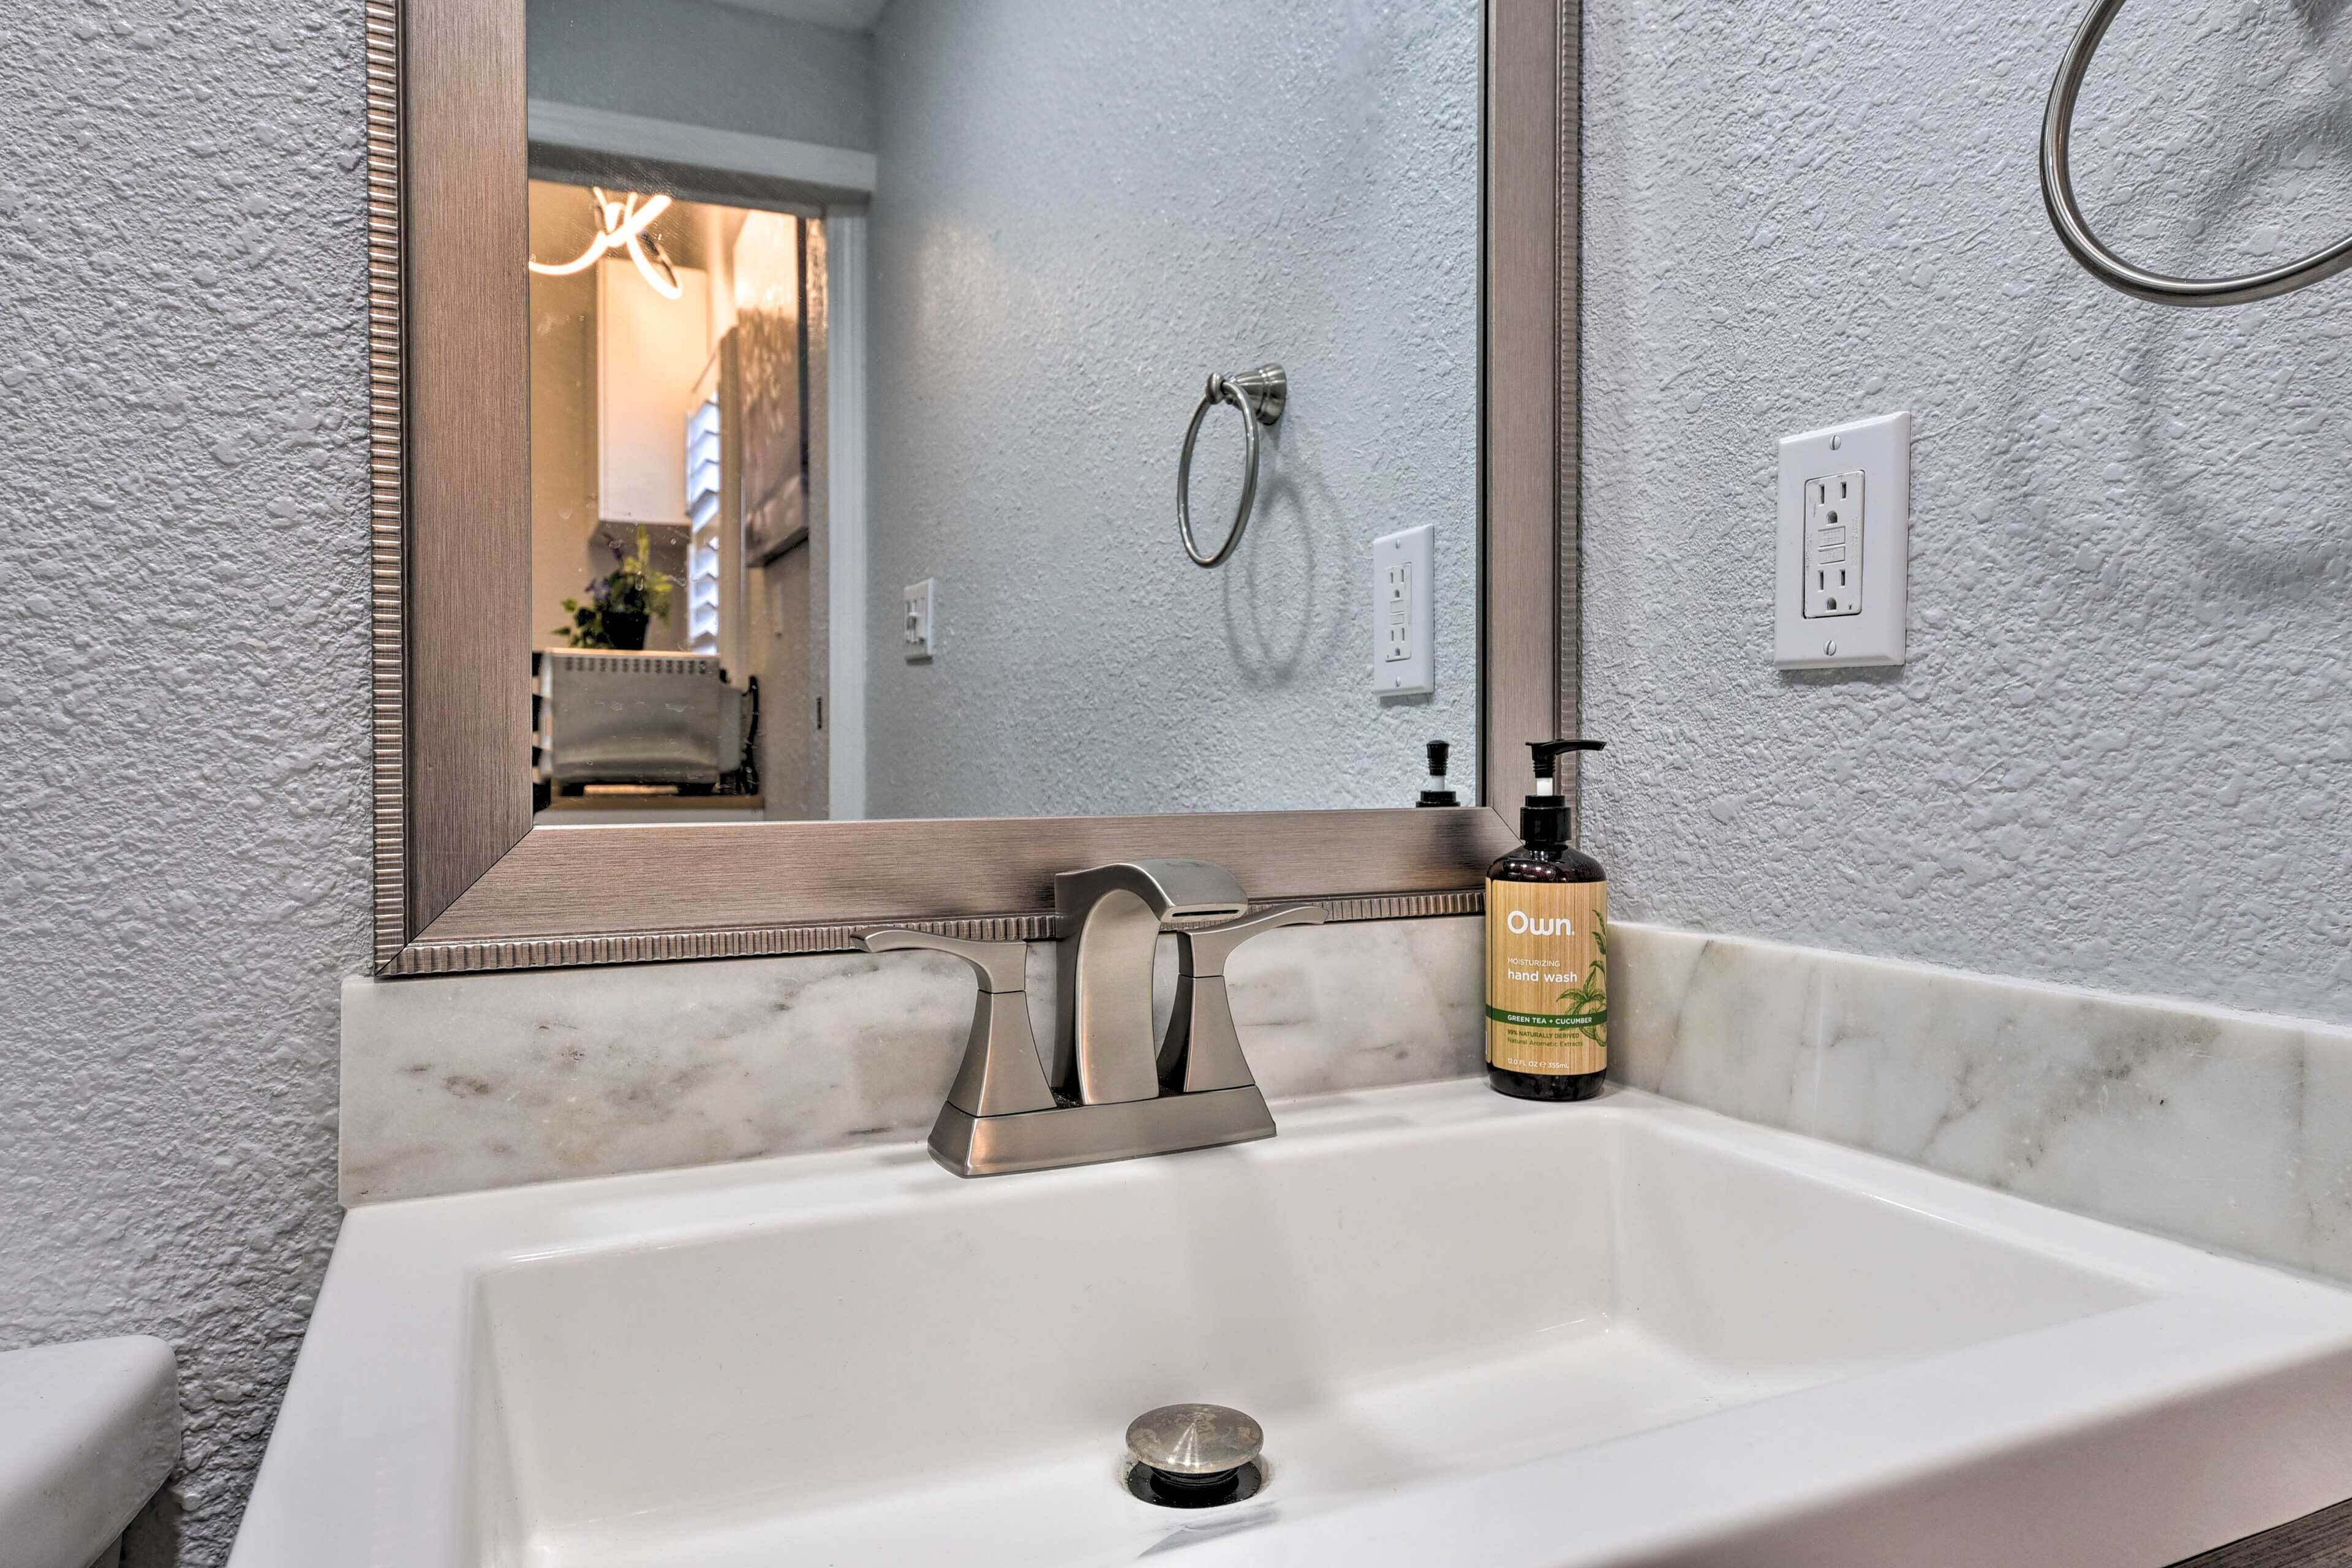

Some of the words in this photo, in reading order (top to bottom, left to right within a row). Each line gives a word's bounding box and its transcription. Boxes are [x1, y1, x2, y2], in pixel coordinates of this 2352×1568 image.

[1507, 958, 1560, 967] MOISTURIZING
[1508, 969, 1539, 982] hand
[1544, 971, 1577, 982] wash
[1507, 1014, 1530, 1023] GREEN
